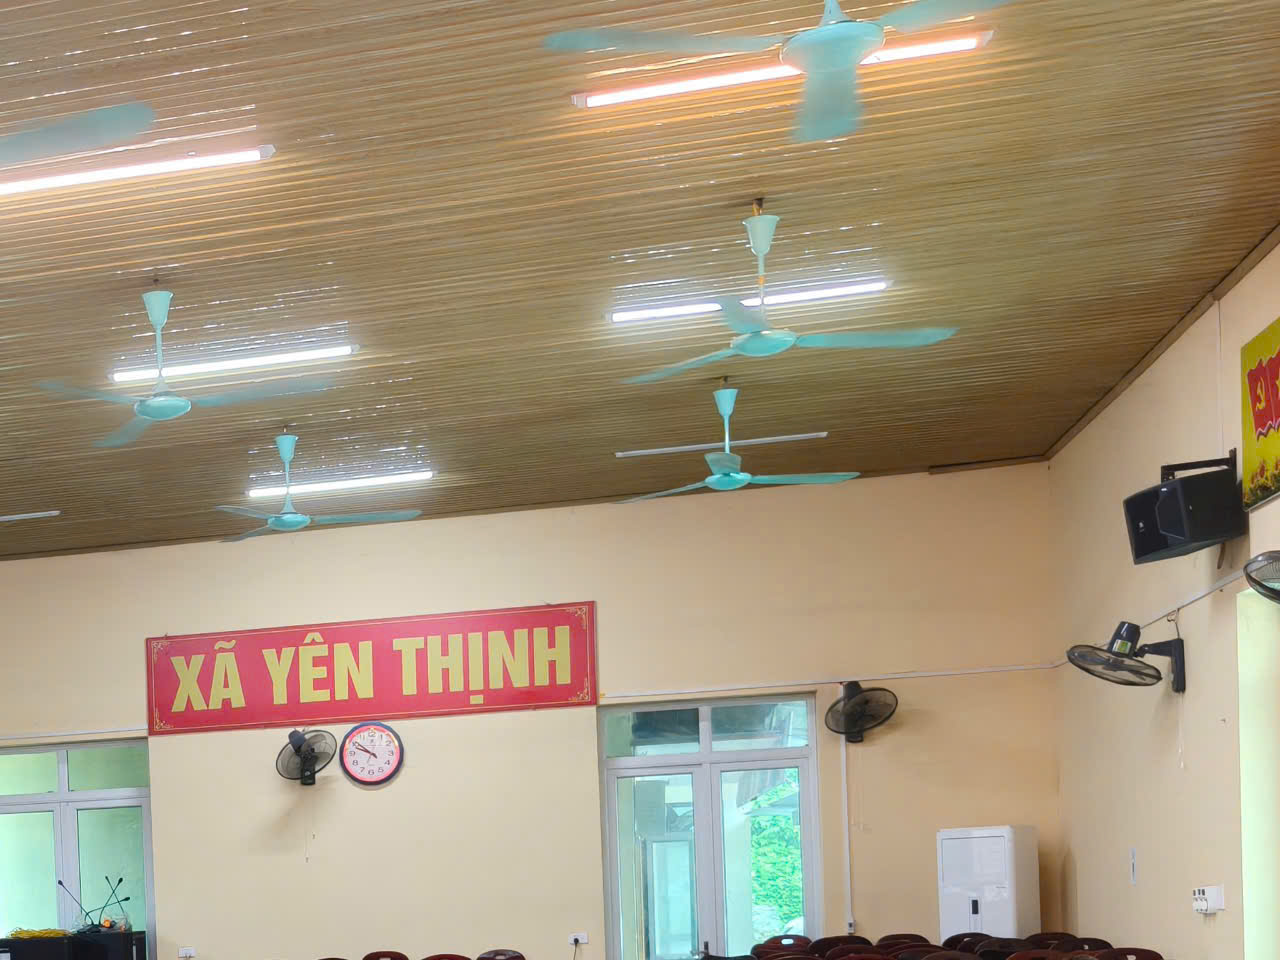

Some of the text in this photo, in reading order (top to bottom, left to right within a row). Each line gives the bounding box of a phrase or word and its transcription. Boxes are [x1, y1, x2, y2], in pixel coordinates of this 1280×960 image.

[171, 625, 571, 713] XÃ YÊN THỊNH
